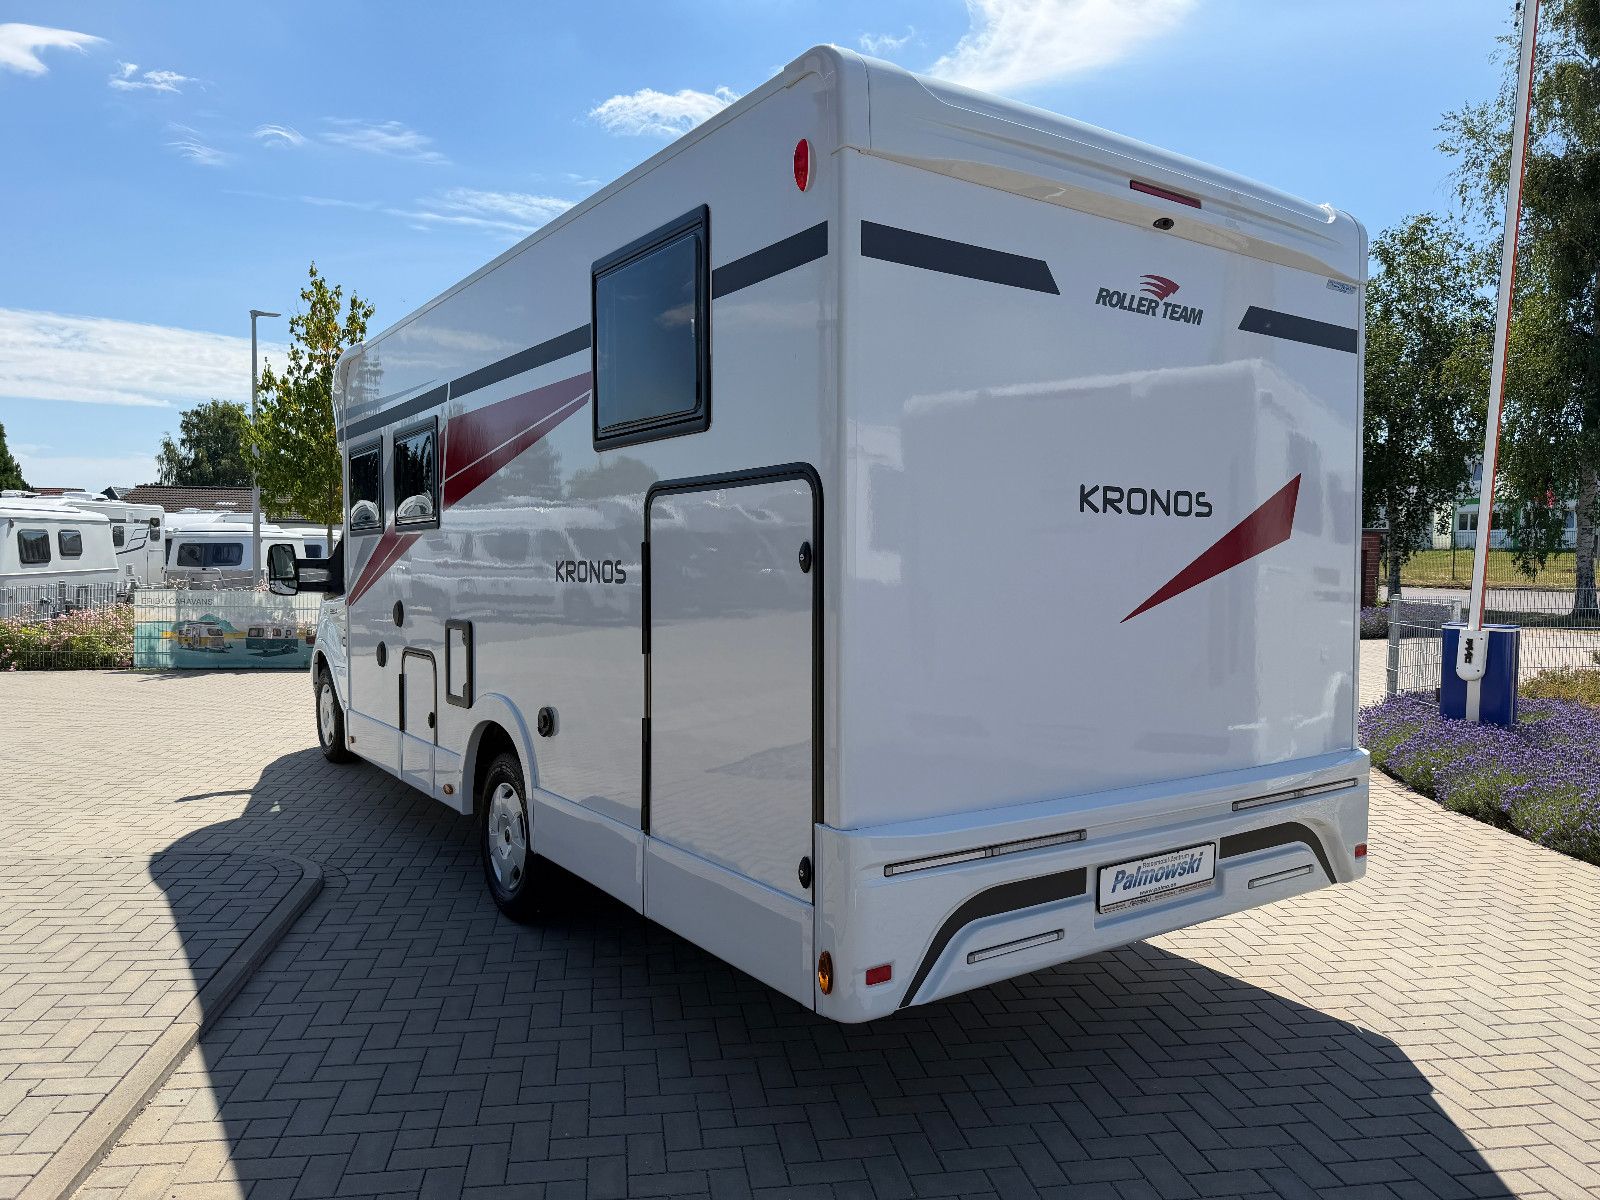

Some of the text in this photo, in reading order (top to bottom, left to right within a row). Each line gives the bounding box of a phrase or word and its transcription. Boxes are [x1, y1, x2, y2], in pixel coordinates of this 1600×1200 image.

[1095, 287, 1204, 326] ROLLER TEAM
[1080, 484, 1213, 518] KRONOS
[555, 559, 627, 584] KRONOS
[1111, 852, 1204, 893] Palmowski
